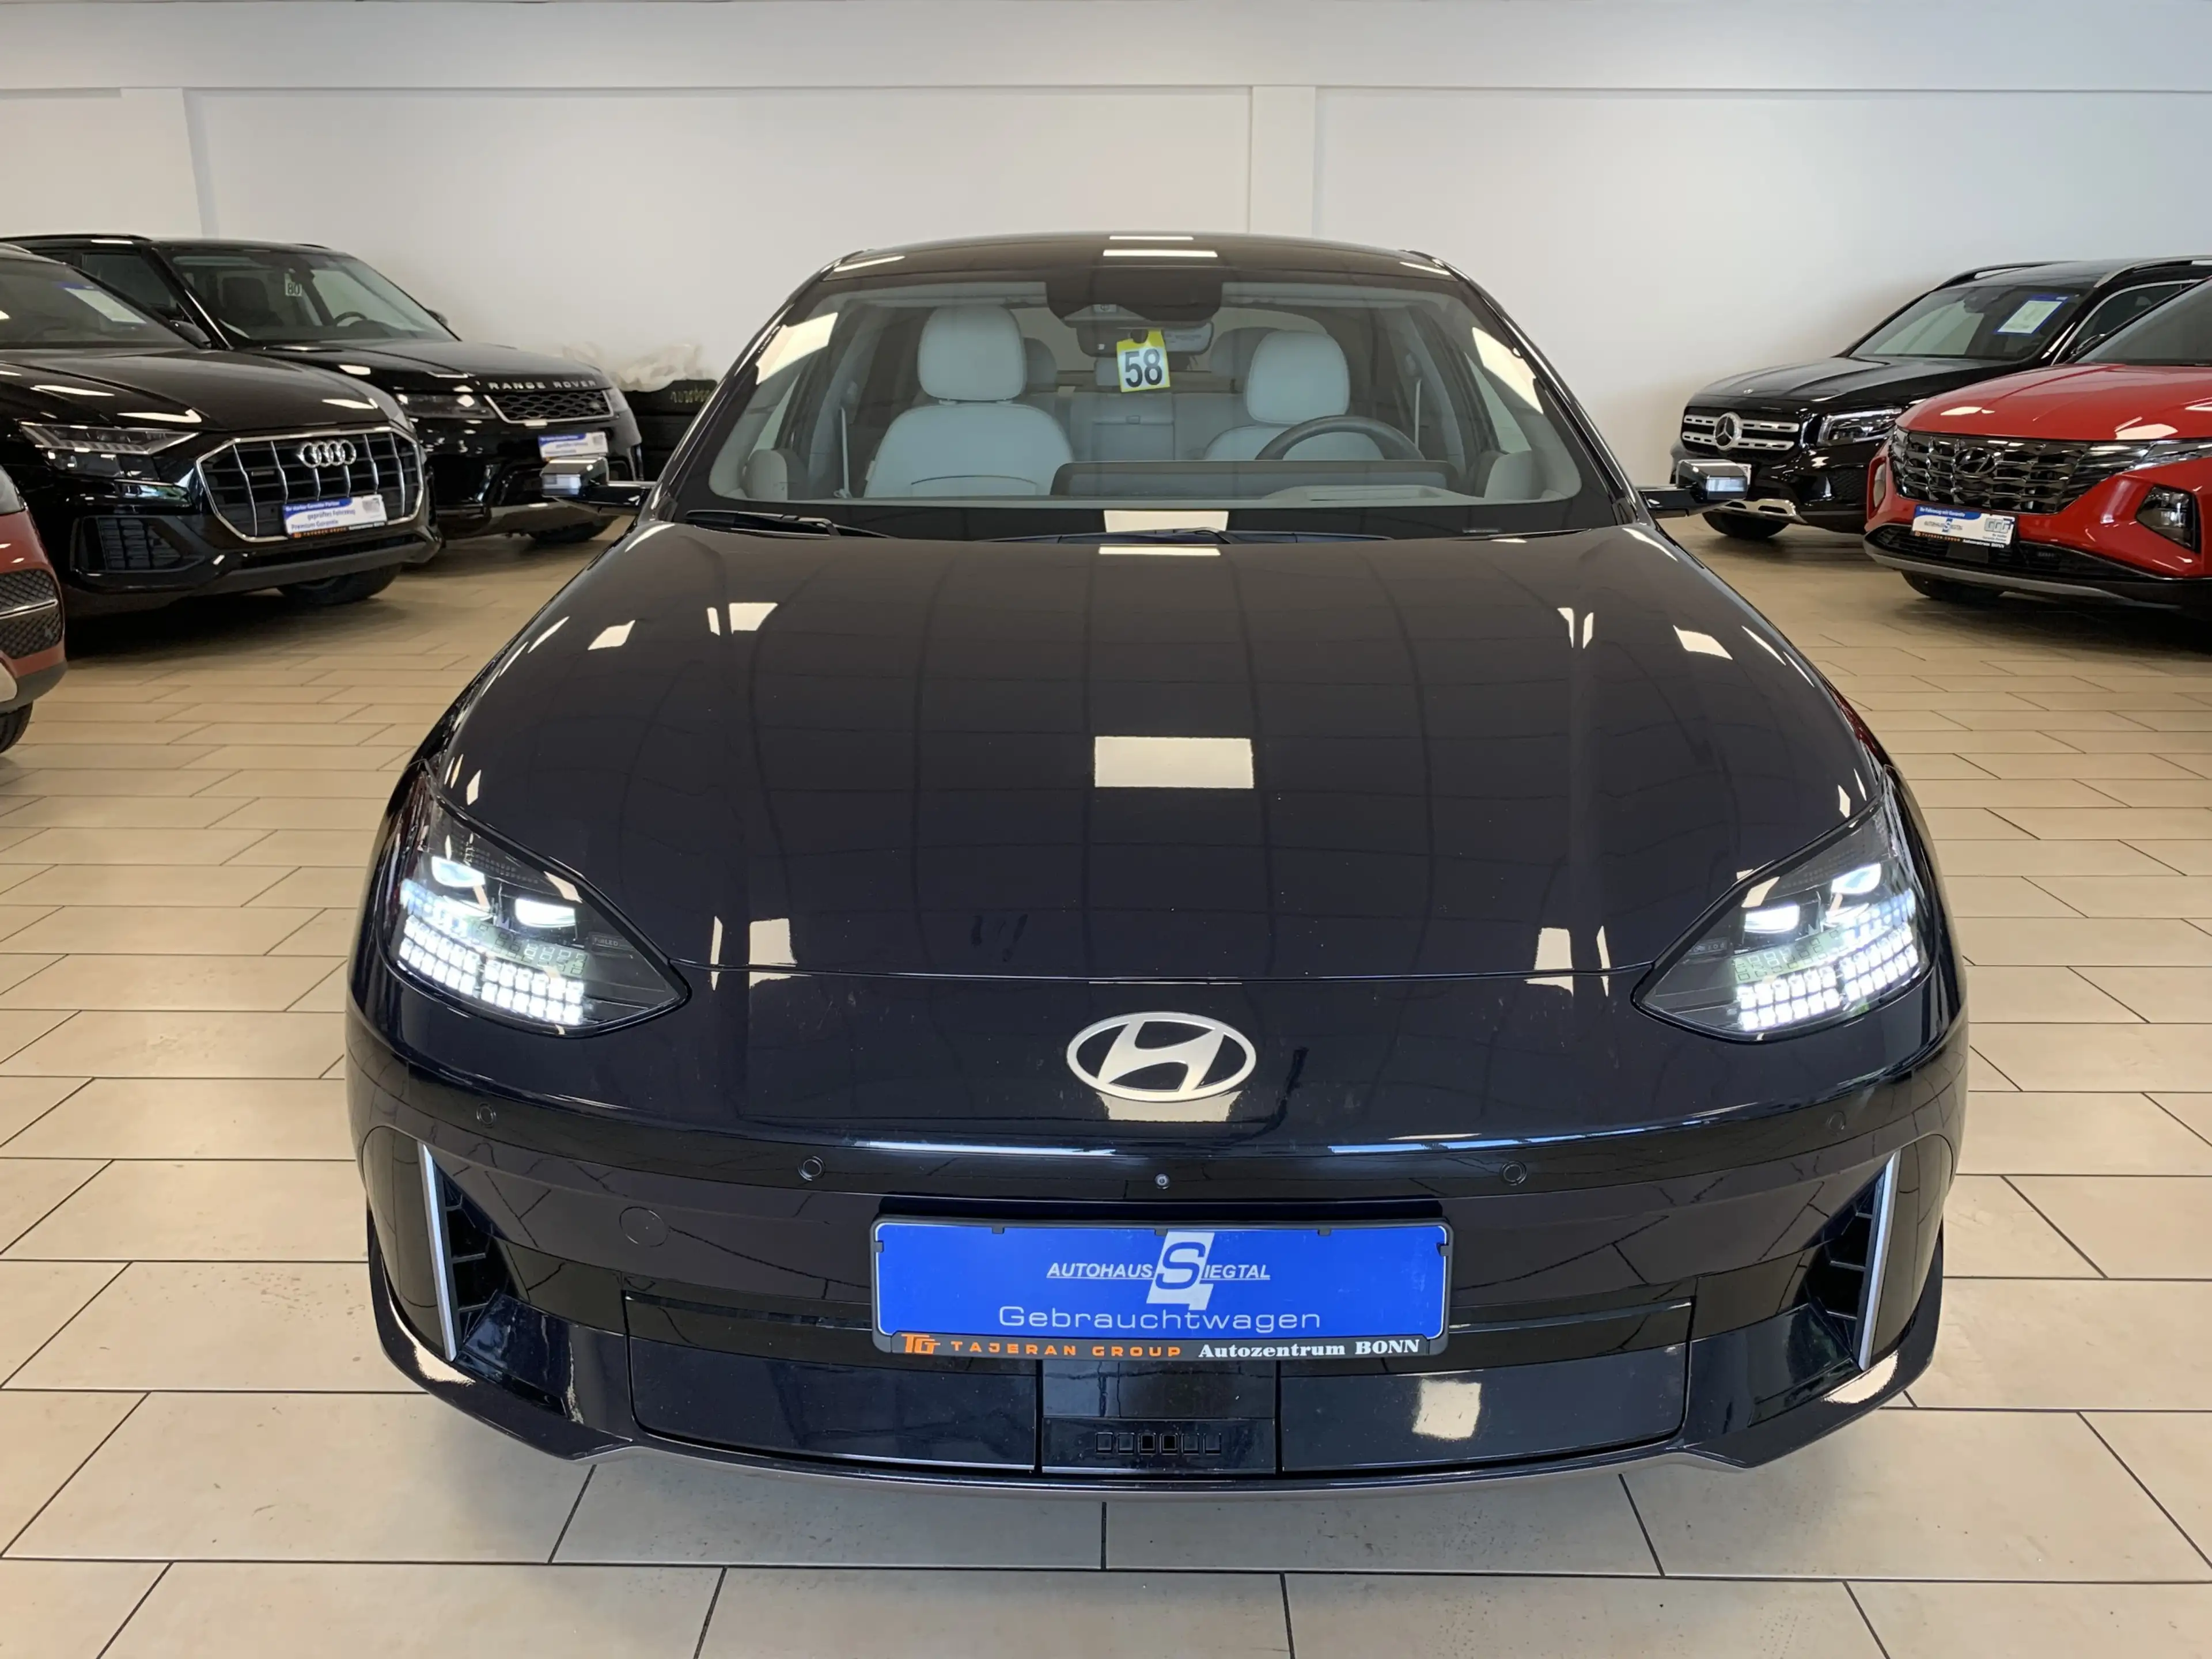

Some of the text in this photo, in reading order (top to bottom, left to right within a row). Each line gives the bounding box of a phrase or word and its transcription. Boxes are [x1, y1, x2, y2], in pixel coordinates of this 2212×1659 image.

[1124, 348, 1162, 388] 58
[488, 380, 596, 390] RANGE ROVER
[1046, 1263, 1153, 1279] AUTOHAUS
[999, 1305, 1321, 1334] Gebrauchtwagen
[950, 1340, 1076, 1356] TAJERAN
[1092, 1346, 1181, 1357] GROUP
[1198, 1343, 1346, 1358] Autozentrum
[1355, 1339, 1420, 1355] BONN
